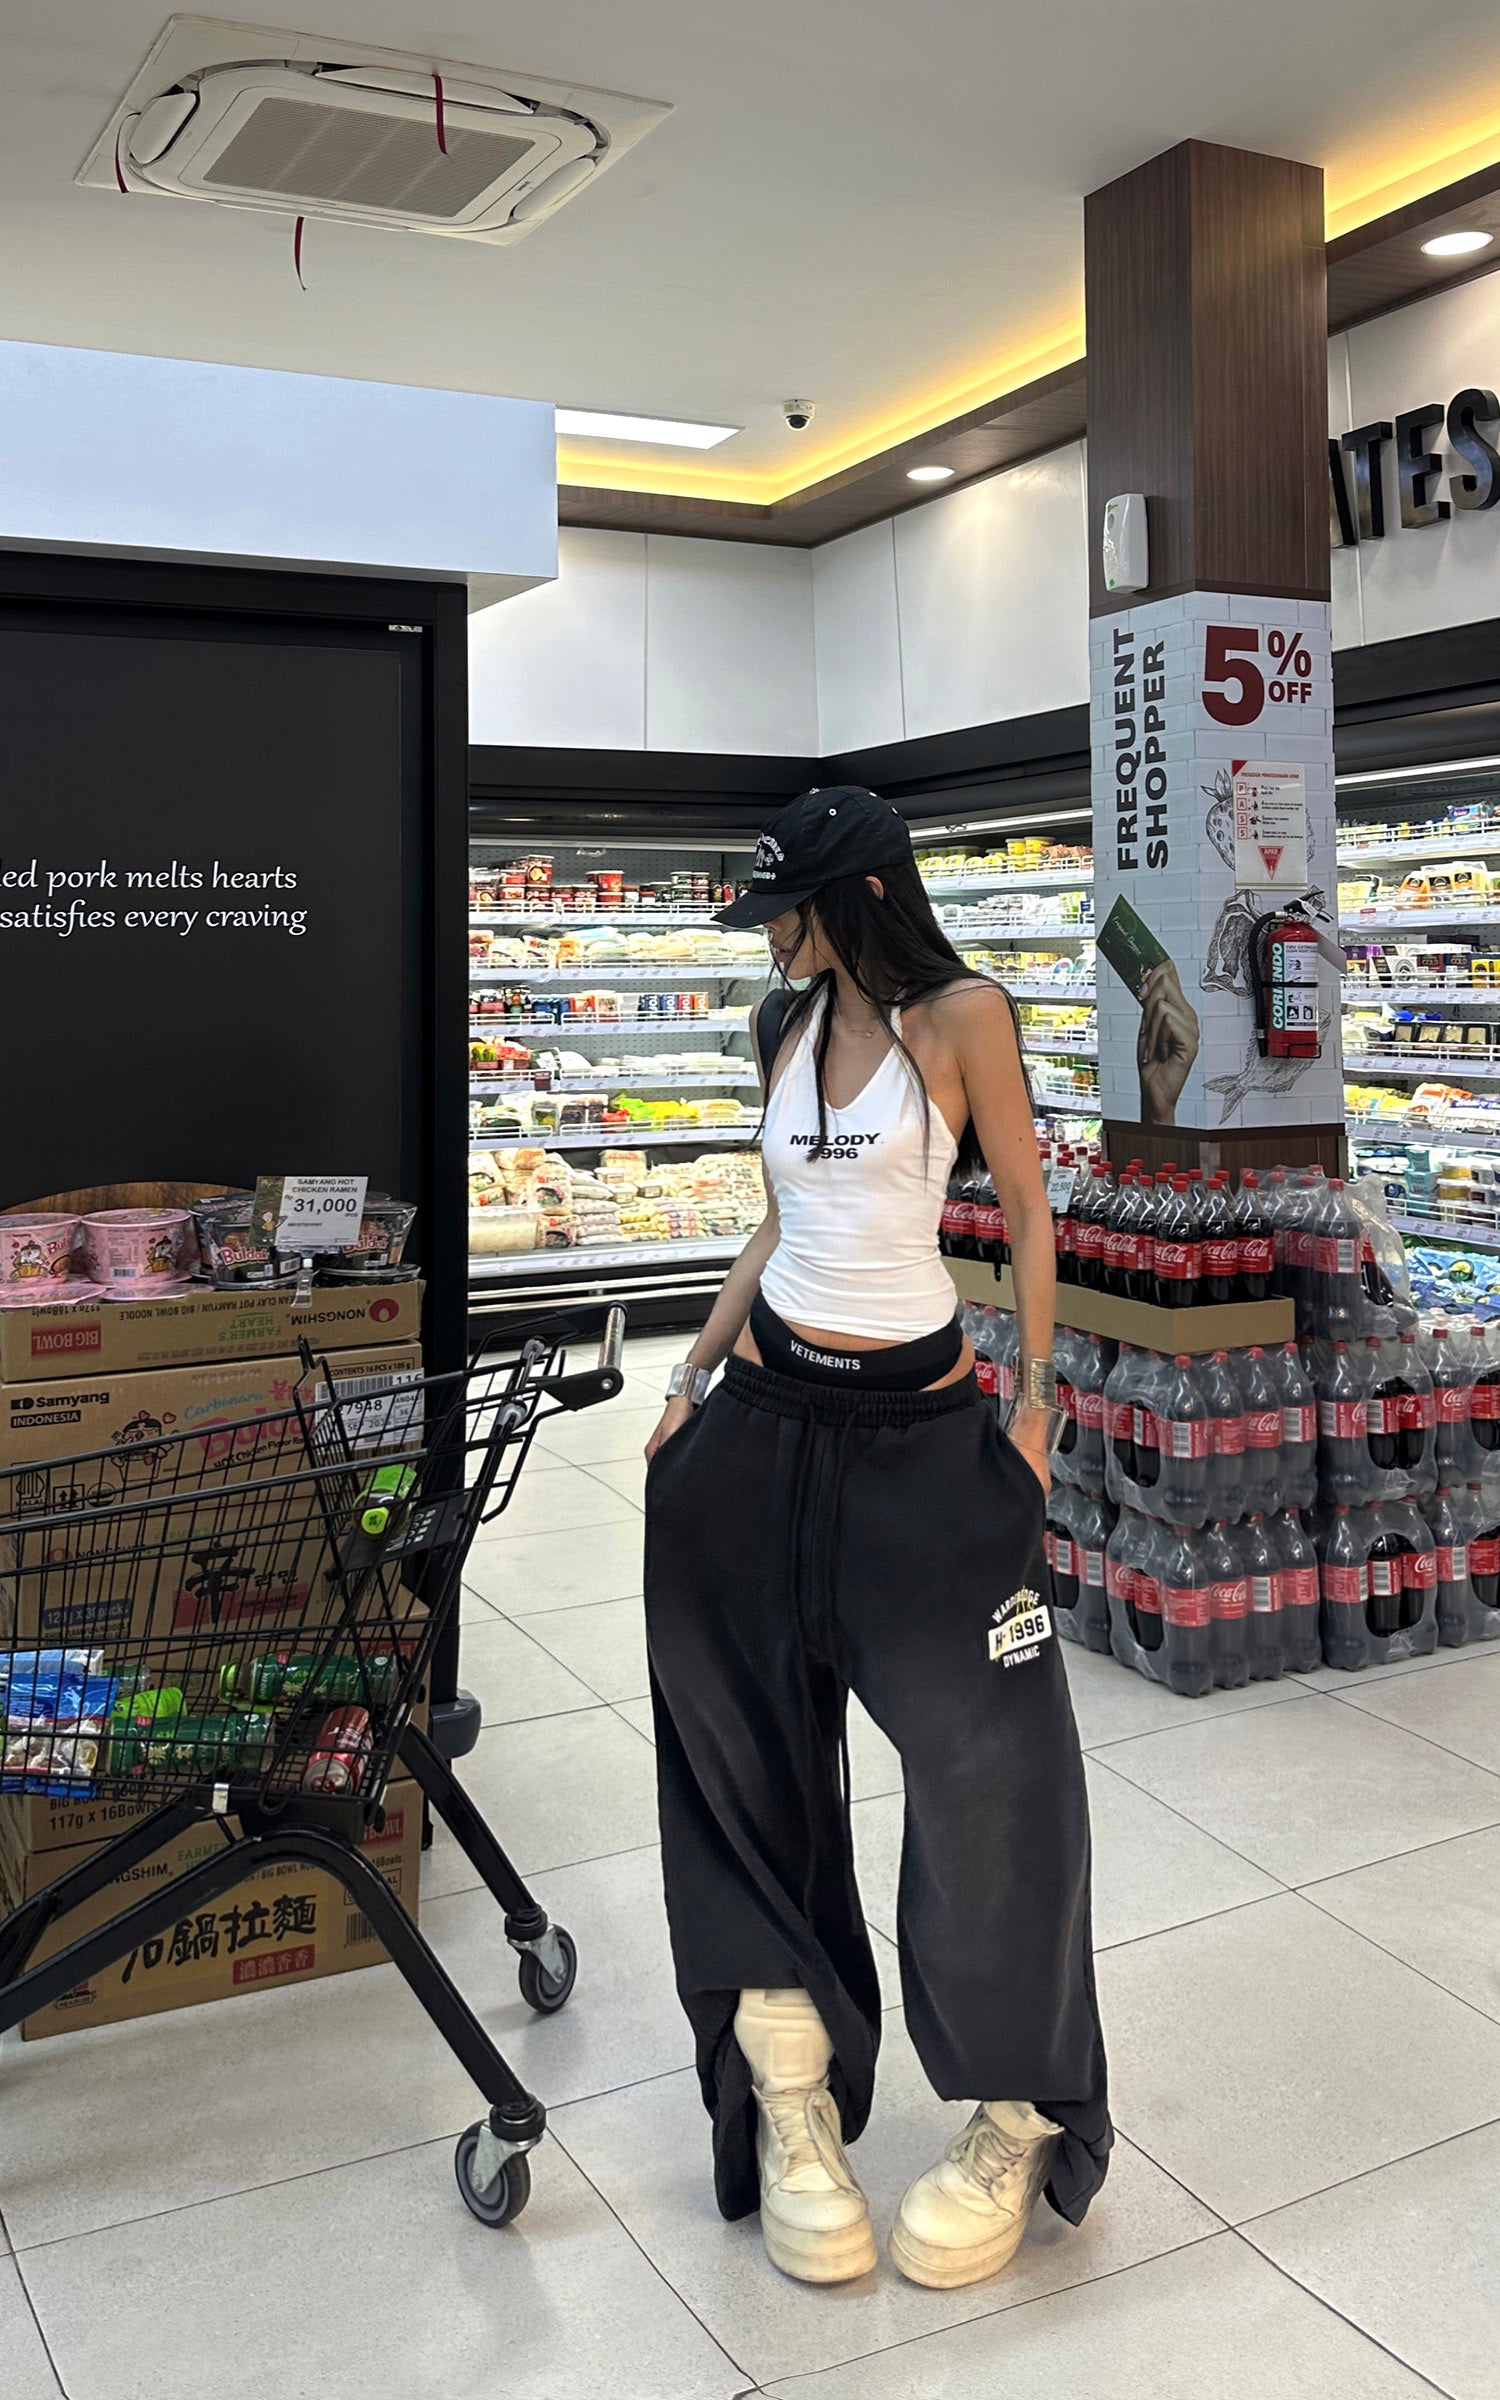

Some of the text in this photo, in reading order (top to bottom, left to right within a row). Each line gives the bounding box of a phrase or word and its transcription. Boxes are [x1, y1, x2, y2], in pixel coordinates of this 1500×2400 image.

[1268, 681, 1312, 703] OFF
[1113, 628, 1141, 871] FREQUENT
[1143, 639, 1168, 869] SHOPPER
[0, 859, 298, 897] ed pork melts hearts
[0, 899, 308, 938] satisfies every craving
[790, 1133, 881, 1146] MELODY
[820, 1148, 859, 1160] 996
[292, 1186, 358, 1194] CHICKEN RAMEN
[294, 1198, 357, 1216] 31,000
[220, 1248, 268, 1266] Buldak
[201, 1300, 237, 1314] RAMYUN
[238, 1298, 256, 1310] POT
[256, 1296, 280, 1306] CLAY
[119, 1310, 153, 1321] NOODLE
[156, 1306, 181, 1318] BOWL
[181, 1304, 195, 1316] BIG
[290, 1308, 366, 1326] NONGSHIM
[230, 1315, 274, 1330] HEART
[33, 1330, 99, 1350] BIG BOWL
[217, 1325, 283, 1342] FARMER'S
[790, 1339, 861, 1371] VETEMENTS
[330, 1366, 365, 1377] CONTENTS
[374, 1363, 388, 1372] PCS
[36, 1392, 109, 1409] Samyang
[183, 1393, 264, 1420] Carbonara
[12, 1411, 79, 1427] INDONESIA
[236, 1444, 268, 1461] Chicken
[1003, 1645, 1040, 1668] DYNAMIC
[49, 1813, 84, 1831] 117g
[101, 1801, 157, 1822] 16Bowls
[261, 1867, 275, 1879] BIG
[276, 1863, 298, 1877] BOWL
